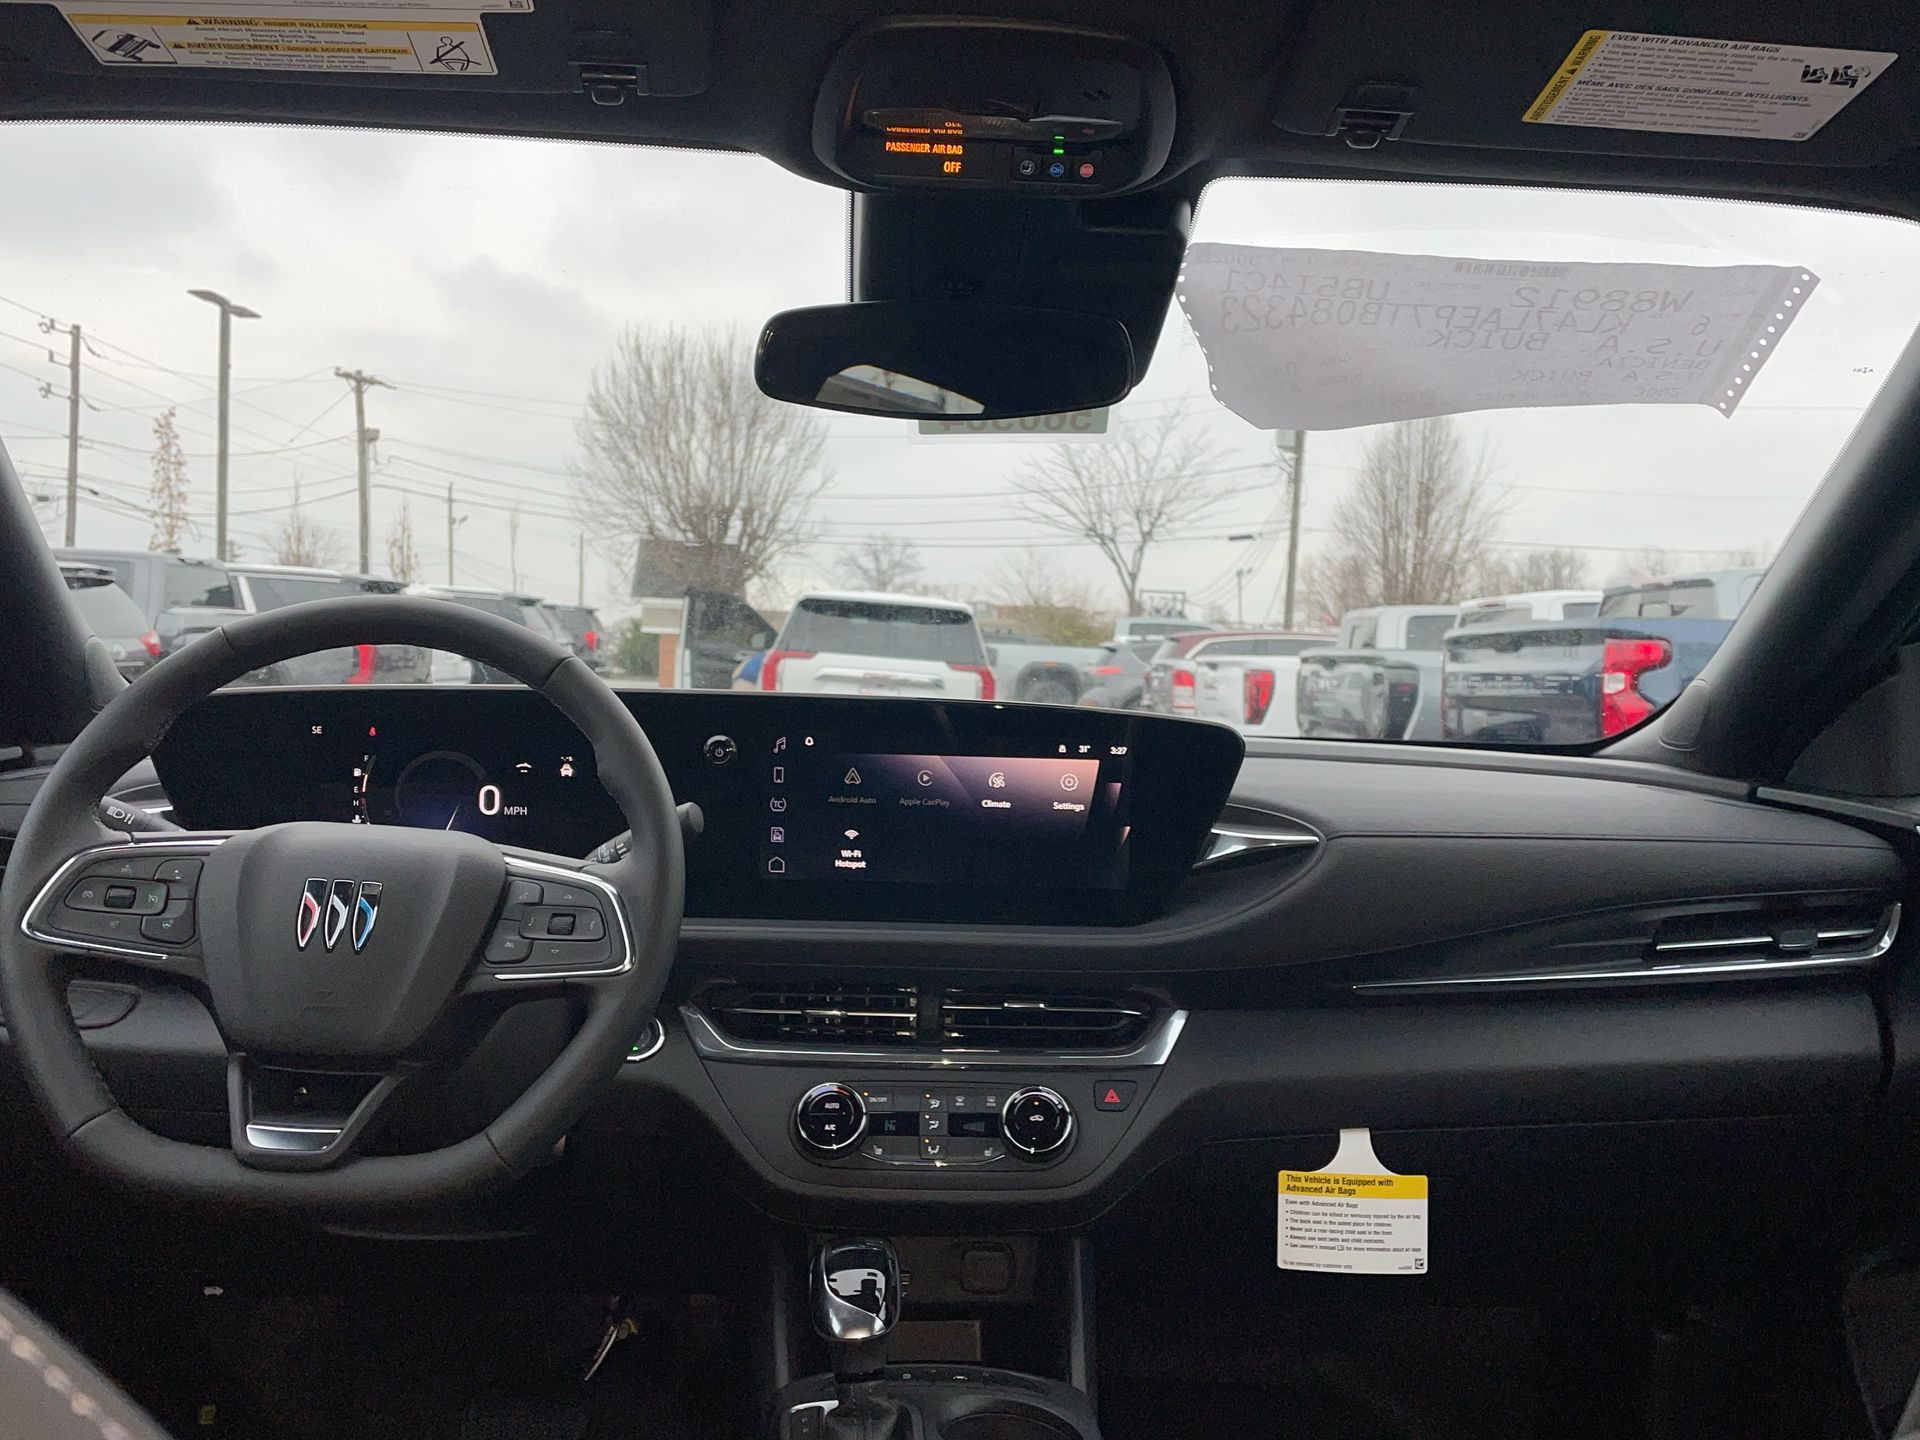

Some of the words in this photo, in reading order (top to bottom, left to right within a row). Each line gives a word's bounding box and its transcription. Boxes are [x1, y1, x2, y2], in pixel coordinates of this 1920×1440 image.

[1610, 34, 1639, 43] EVEN
[1670, 38, 1728, 49] ADVANCED
[886, 142, 930, 153] PASSENGER
[932, 144, 946, 154] AIR
[947, 144, 962, 155] BAG
[944, 160, 961, 173] OFF
[312, 726, 322, 734] SE
[1110, 747, 1127, 755] 3:27
[478, 785, 500, 815] 0
[504, 807, 527, 815] MPH
[828, 795, 858, 804] Android
[899, 798, 920, 806] Apple
[922, 798, 950, 808] CarPlay
[981, 800, 1011, 809] Climate
[1053, 802, 1084, 812] Settings
[835, 859, 866, 870] Hotspot
[1304, 1175, 1330, 1184] Vehicle
[1341, 1177, 1375, 1187] Equipped
[1285, 1185, 1322, 1194] Advanced
[1337, 1188, 1356, 1197] Bags
